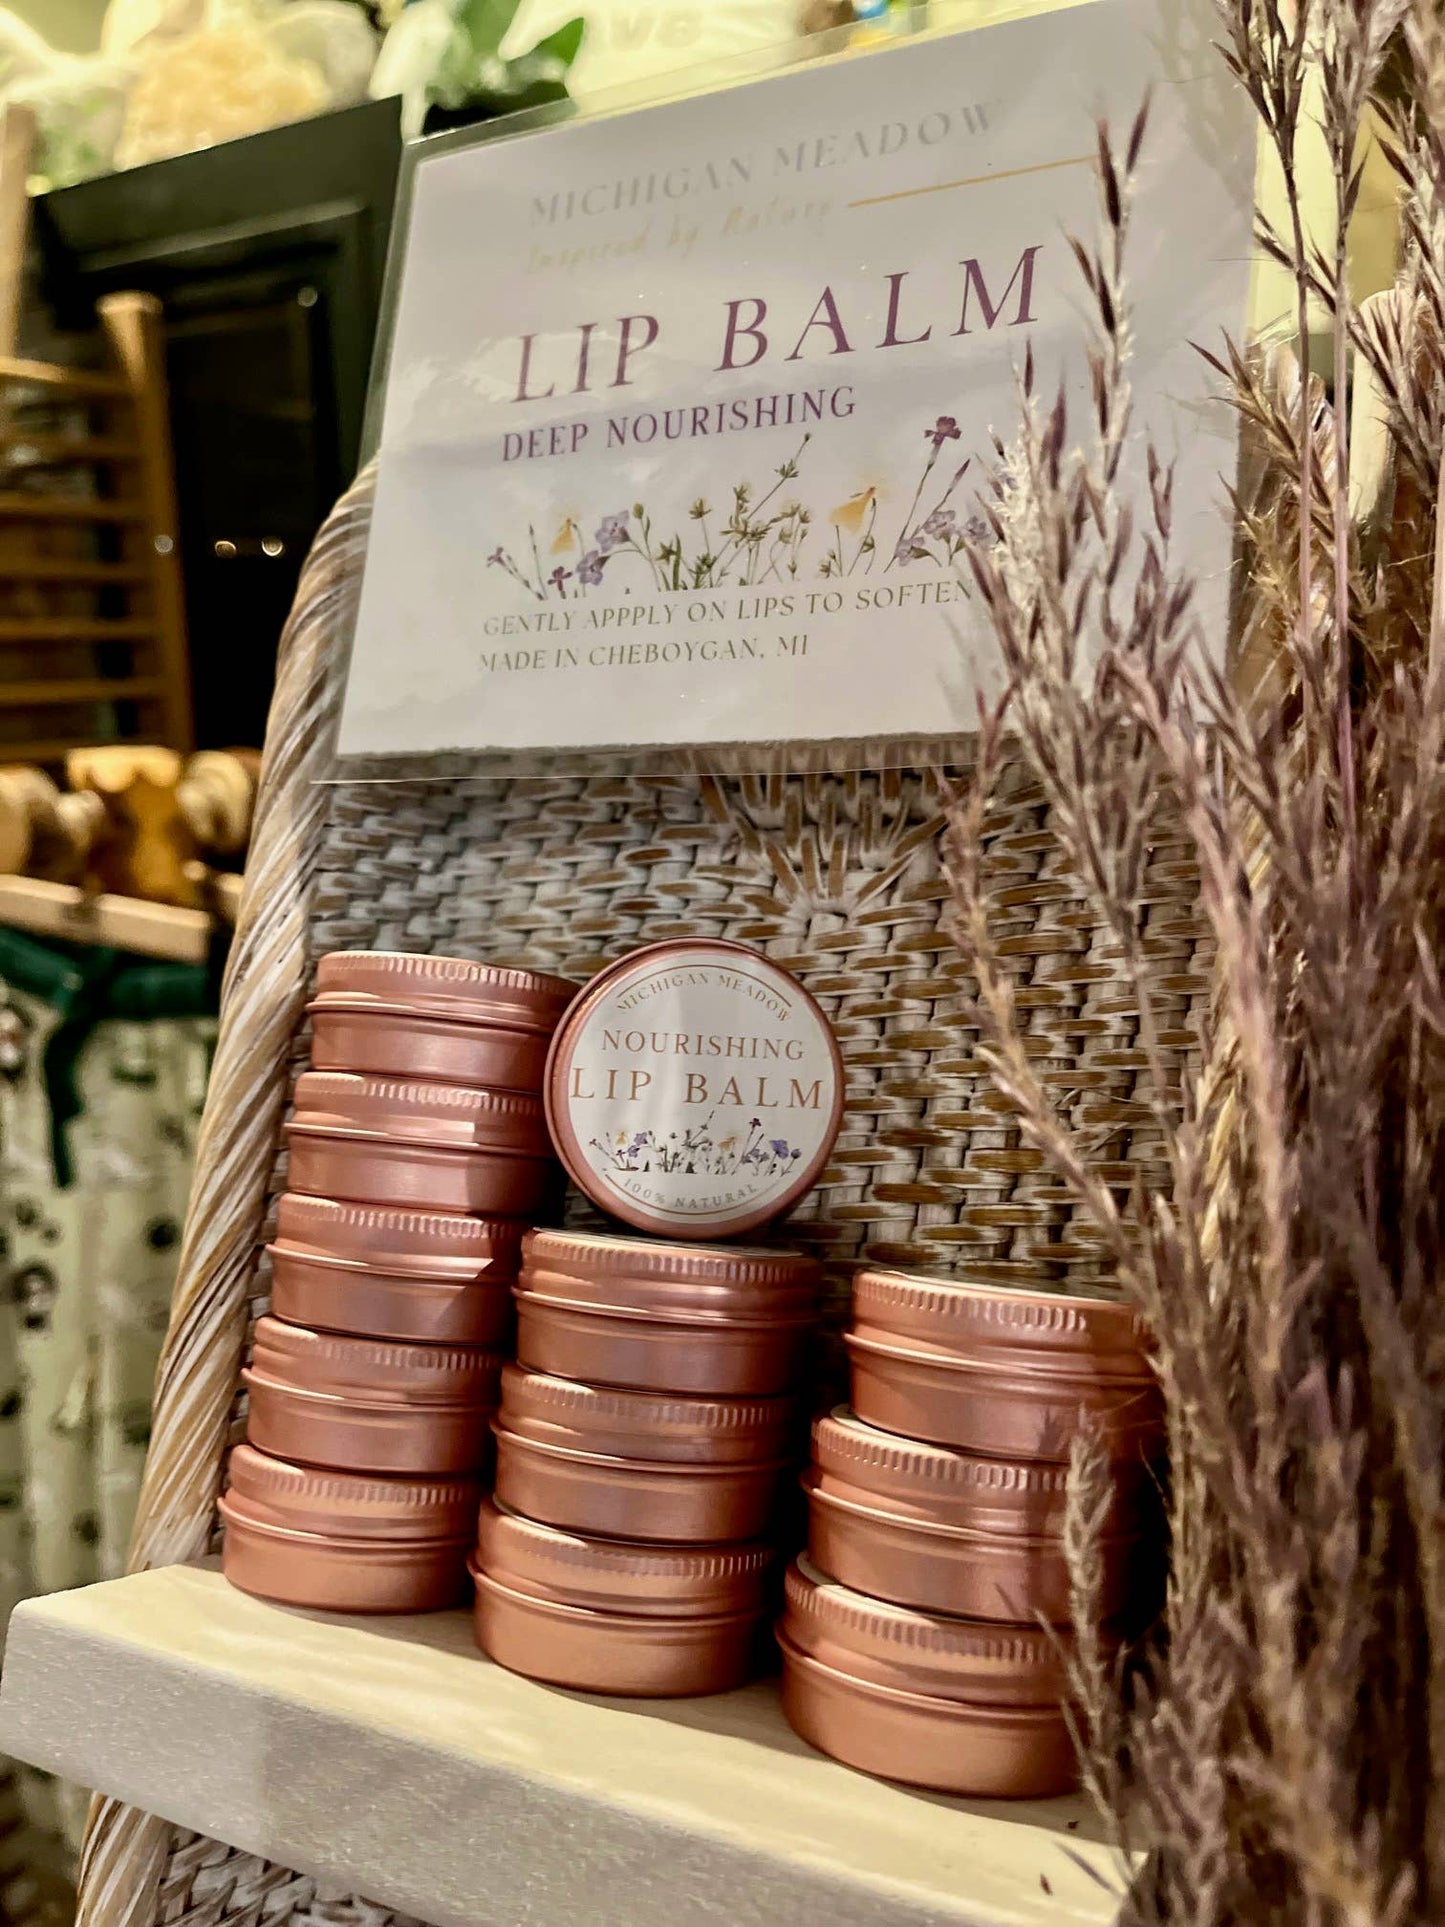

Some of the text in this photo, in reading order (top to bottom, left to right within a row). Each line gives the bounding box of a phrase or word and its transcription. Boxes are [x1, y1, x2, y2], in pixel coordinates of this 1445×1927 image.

[530, 101, 996, 227] MICHIGAN MEADOW
[666, 214, 701, 258] by
[511, 244, 1044, 403] LIP BALM
[503, 386, 857, 462] DEEP NOURISHING
[483, 612, 576, 635] GENTLY
[584, 604, 679, 629] APPPLY
[687, 601, 726, 622] ON
[738, 596, 795, 619] LIPS
[805, 590, 845, 614] TO
[479, 634, 808, 672] MADE IN CHEBOYGAN, MI
[617, 973, 792, 1022] MICHIGAN MEADOW
[602, 1029, 804, 1060] NOURISHING
[571, 1067, 824, 1109] LIP BALM
[622, 1178, 758, 1209] 100% NATURAL
